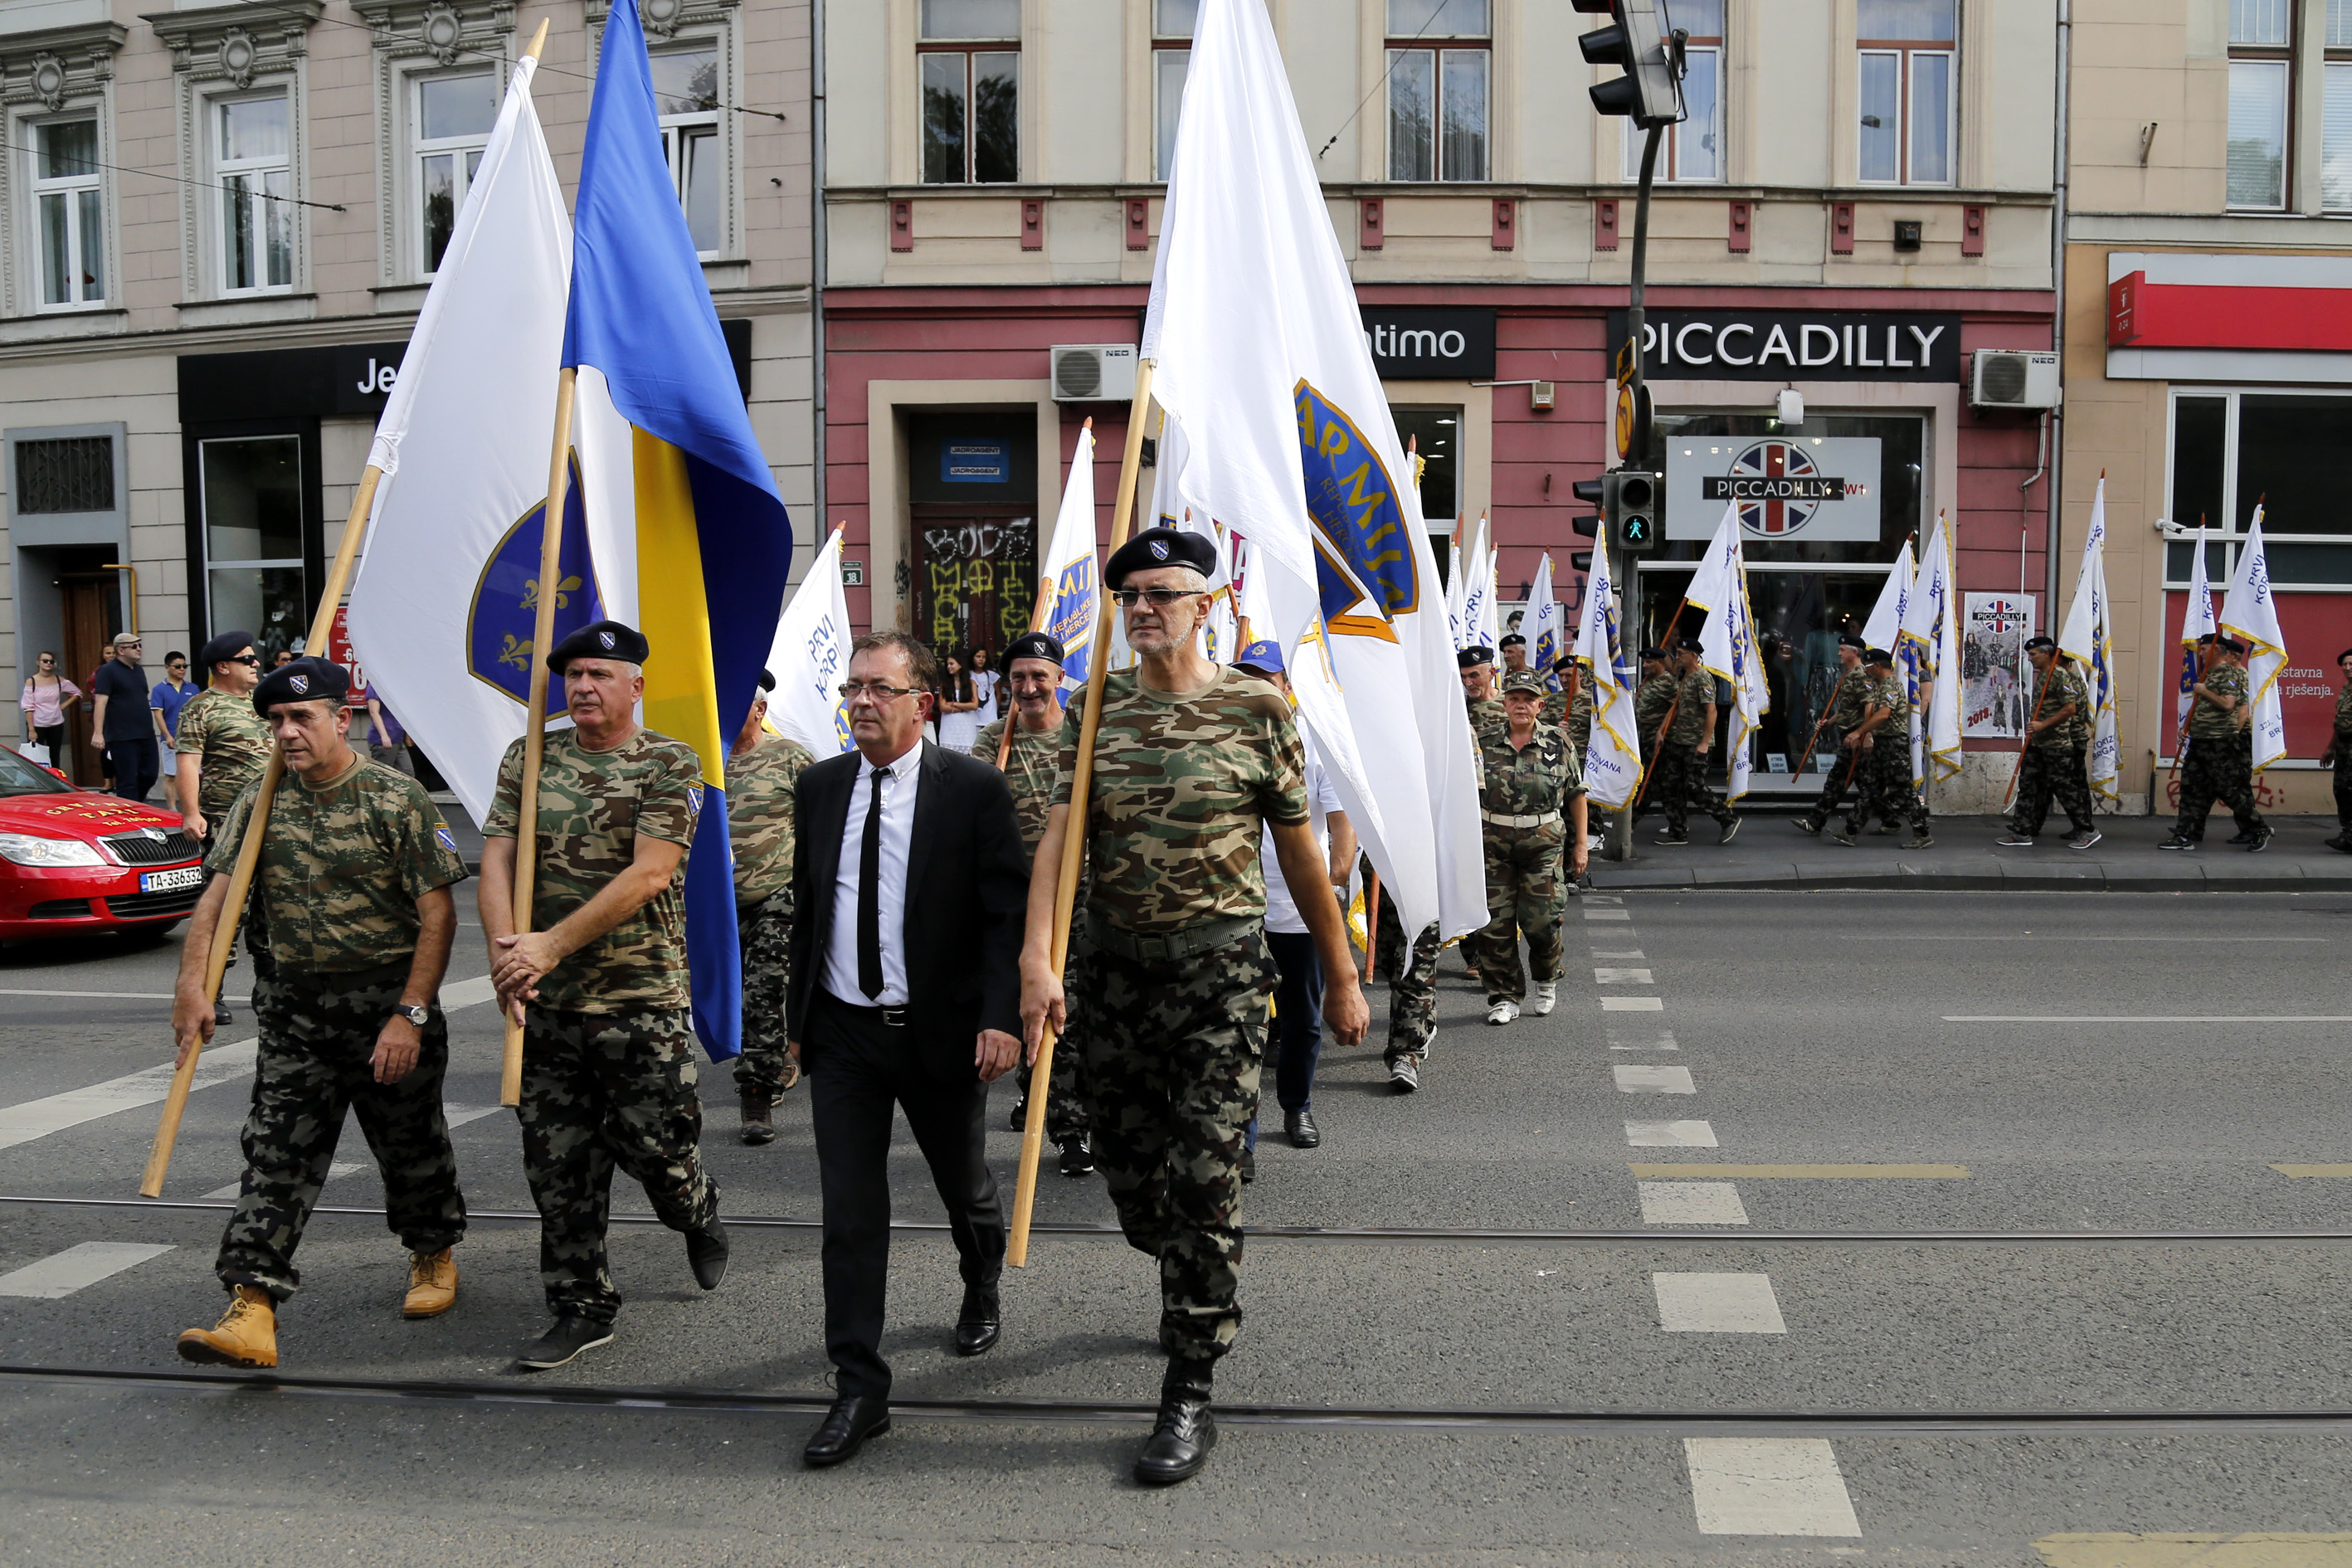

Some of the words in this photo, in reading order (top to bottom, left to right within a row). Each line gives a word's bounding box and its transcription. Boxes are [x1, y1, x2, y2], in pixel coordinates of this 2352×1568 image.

[1717, 480, 1830, 497] PICCADILLY
[1844, 484, 1864, 495] W1
[847, 572, 857, 582] 18
[2248, 554, 2265, 586] PRVI
[1977, 613, 2021, 621] PICCADILLY
[808, 614, 835, 662] PRVI
[2286, 684, 2334, 699] rješenja.
[1967, 708, 1993, 728] 2018.
[46, 801, 132, 815] CRVENI
[79, 809, 139, 819] TAXI
[148, 868, 202, 889] TA-336332
